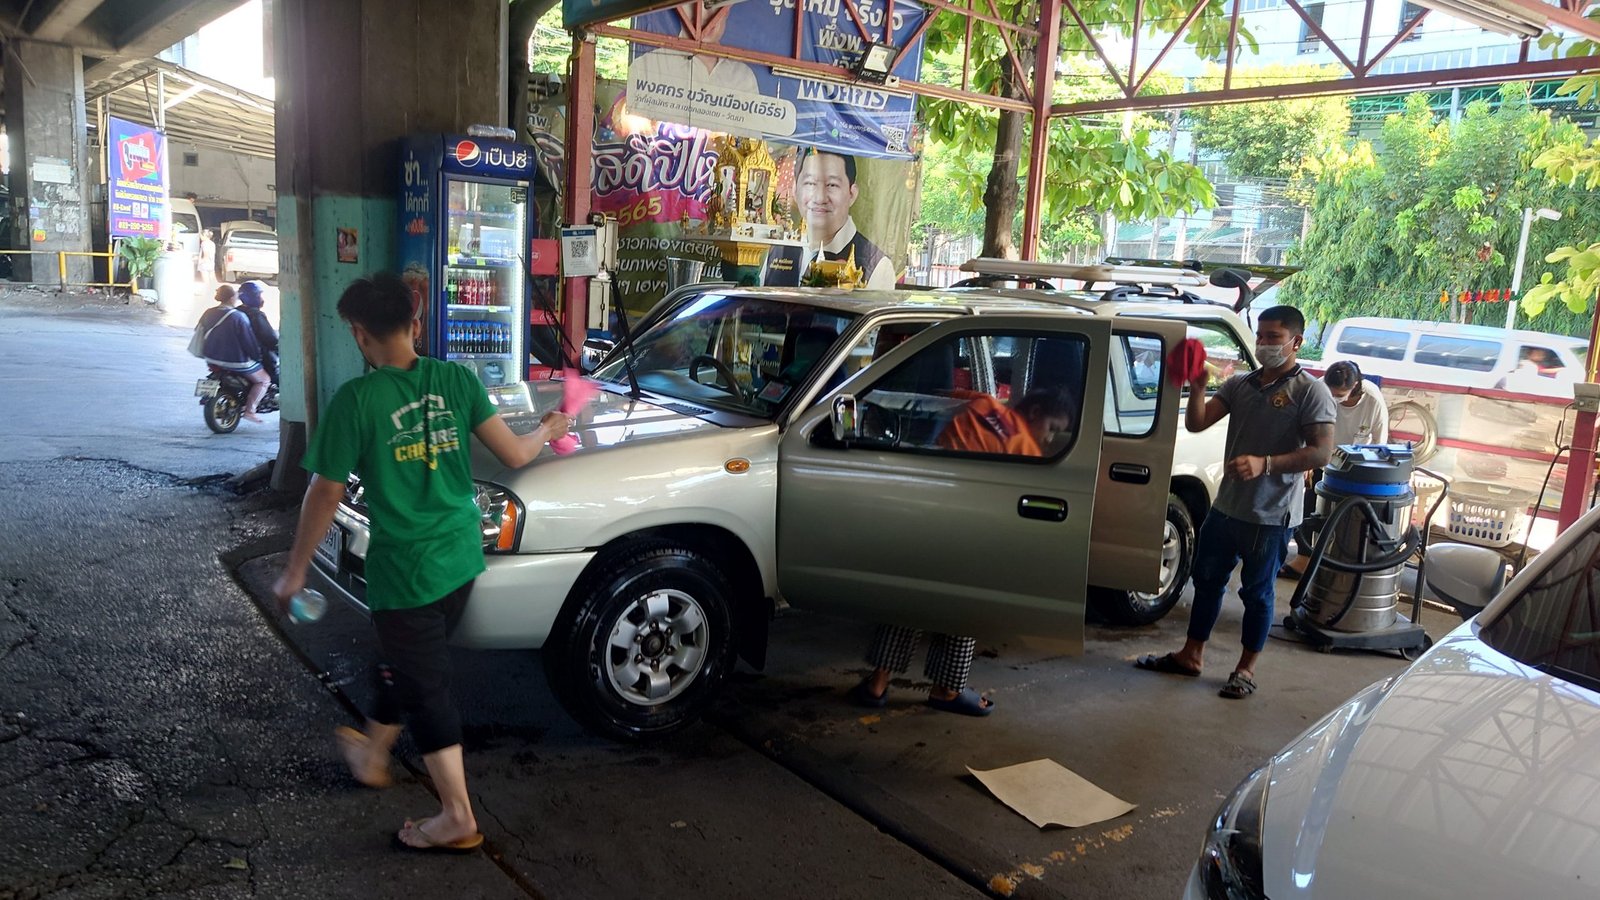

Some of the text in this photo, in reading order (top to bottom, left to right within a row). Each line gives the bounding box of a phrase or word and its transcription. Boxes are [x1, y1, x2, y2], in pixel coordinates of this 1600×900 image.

[635, 79, 684, 98] พงศกร
[485, 147, 528, 169] เป๊ปซี่
